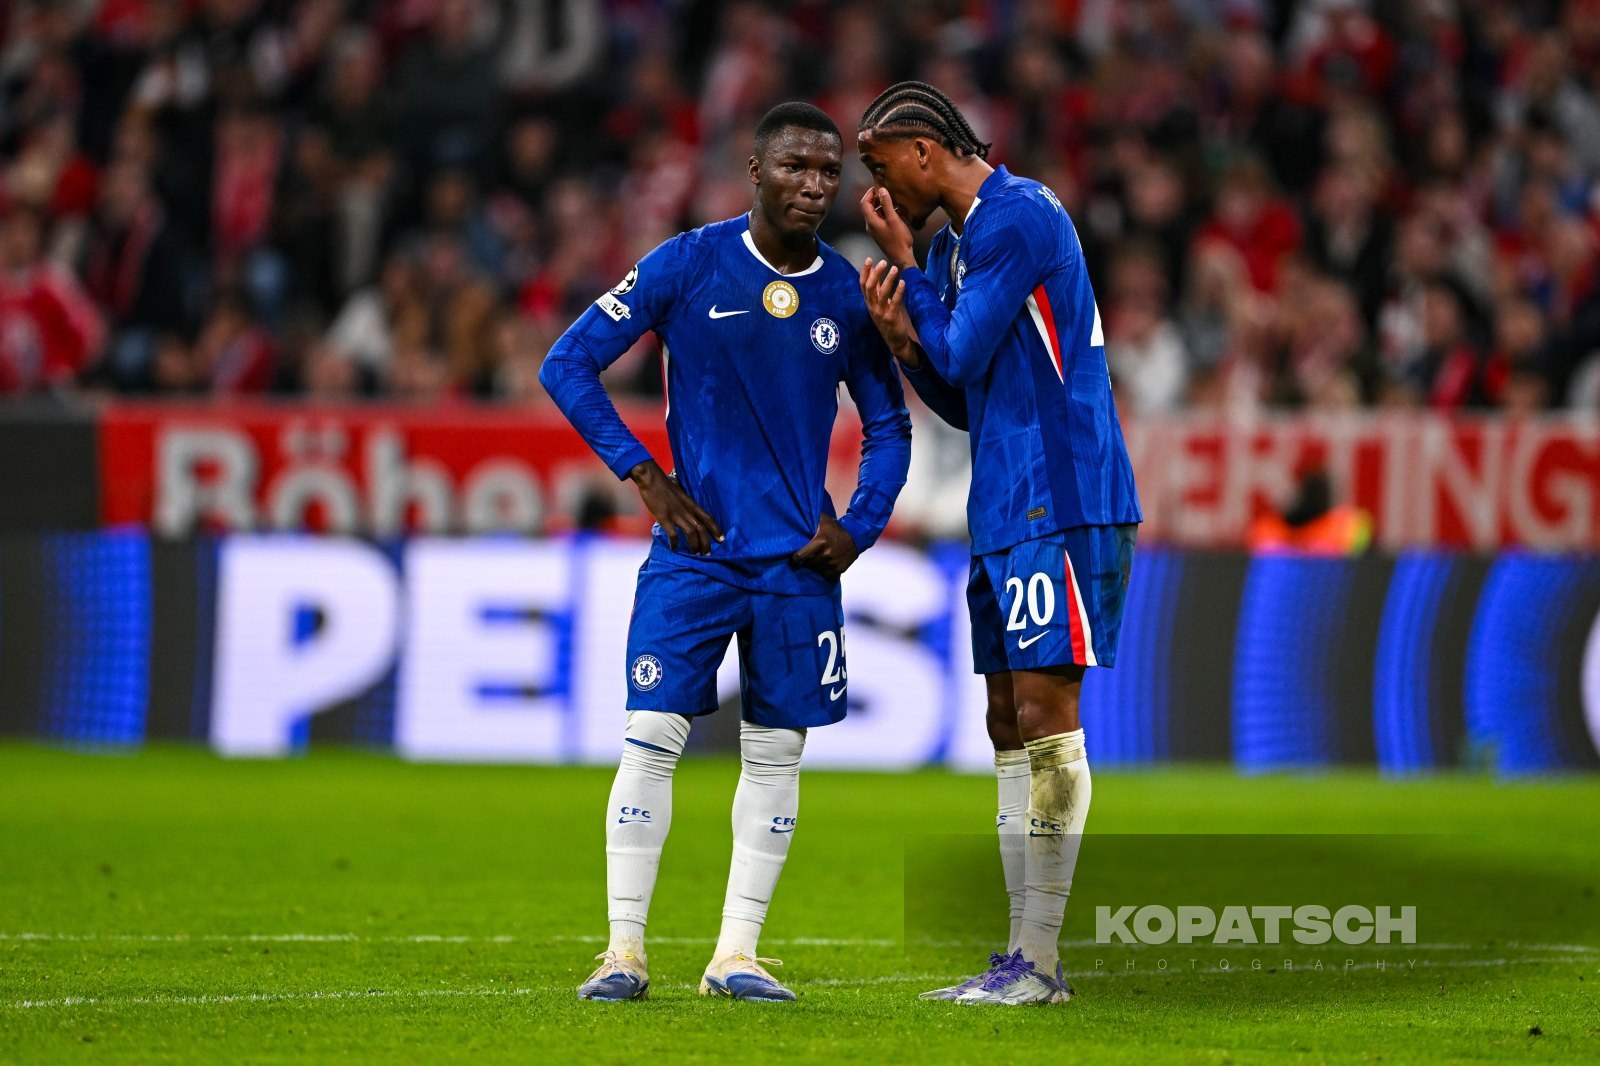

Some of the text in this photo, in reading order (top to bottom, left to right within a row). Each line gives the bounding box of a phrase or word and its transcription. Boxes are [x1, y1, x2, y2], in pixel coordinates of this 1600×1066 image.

[766, 283, 797, 307] WORLD CHAMPIONS
[772, 307, 787, 316] FIFA
[1006, 572, 1055, 631] 20
[620, 806, 652, 819] CFC
[1031, 818, 1062, 832] CFC
